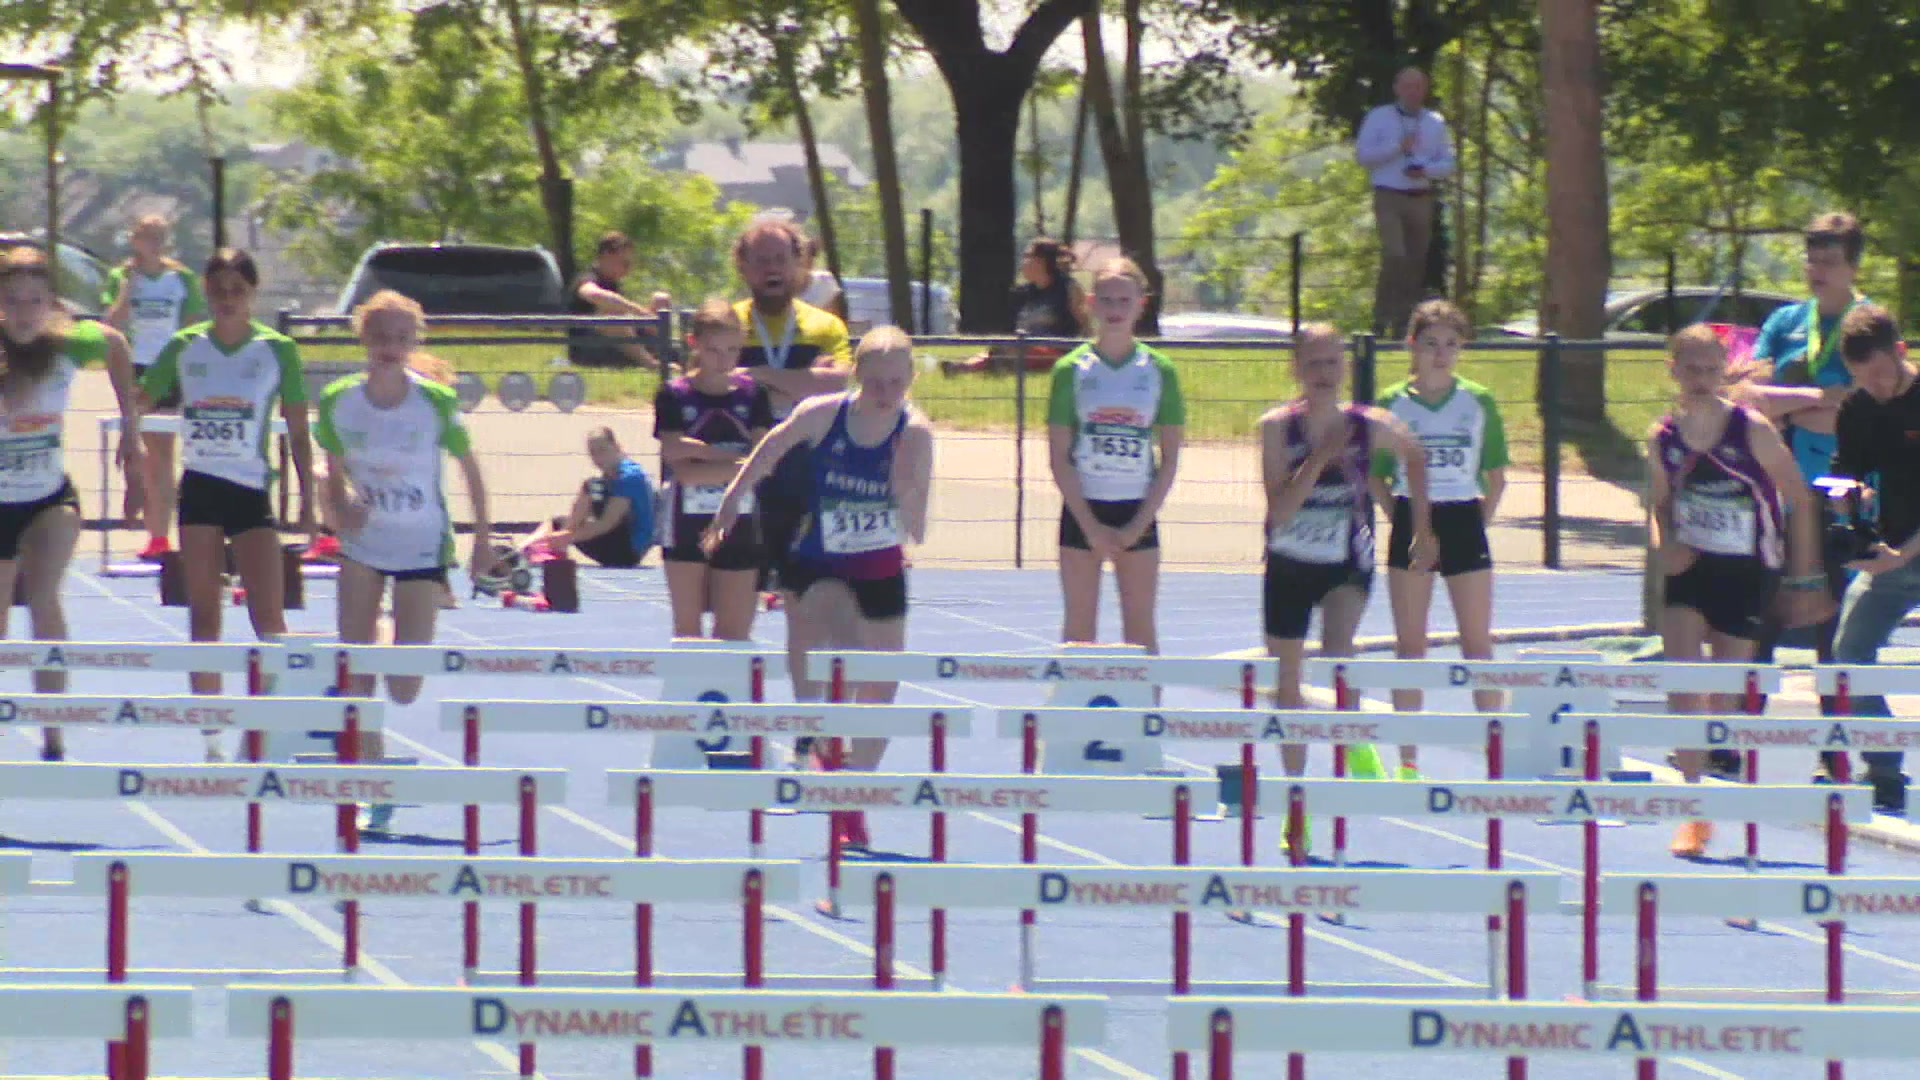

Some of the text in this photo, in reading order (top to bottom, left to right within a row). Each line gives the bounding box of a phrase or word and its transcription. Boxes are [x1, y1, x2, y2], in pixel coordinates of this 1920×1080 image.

[190, 421, 246, 440] 2061
[1091, 436, 1142, 459] 1632
[831, 508, 891, 533] 3121
[115, 701, 235, 724] ATHLETIC
[586, 706, 825, 732] DYNAMIC ATHLETIC
[1143, 714, 1379, 740] DYNAMIC ATHLETIC
[1706, 721, 1818, 746] DYNAMIC
[119, 769, 395, 799] DYNAMIC ATHLETIC
[776, 778, 1051, 809] DYNAMIC ATHLETIC
[1429, 787, 1703, 817] DYNAMIC ATHLETIC
[289, 863, 611, 896] DYNAMIC ATHLETIC
[1039, 873, 1360, 907] DYNAMIC ATHLETIC
[473, 997, 863, 1038] DYNAMIC ATHLETIC
[1411, 1011, 1804, 1052] DYNAMIC ATHLETIC
